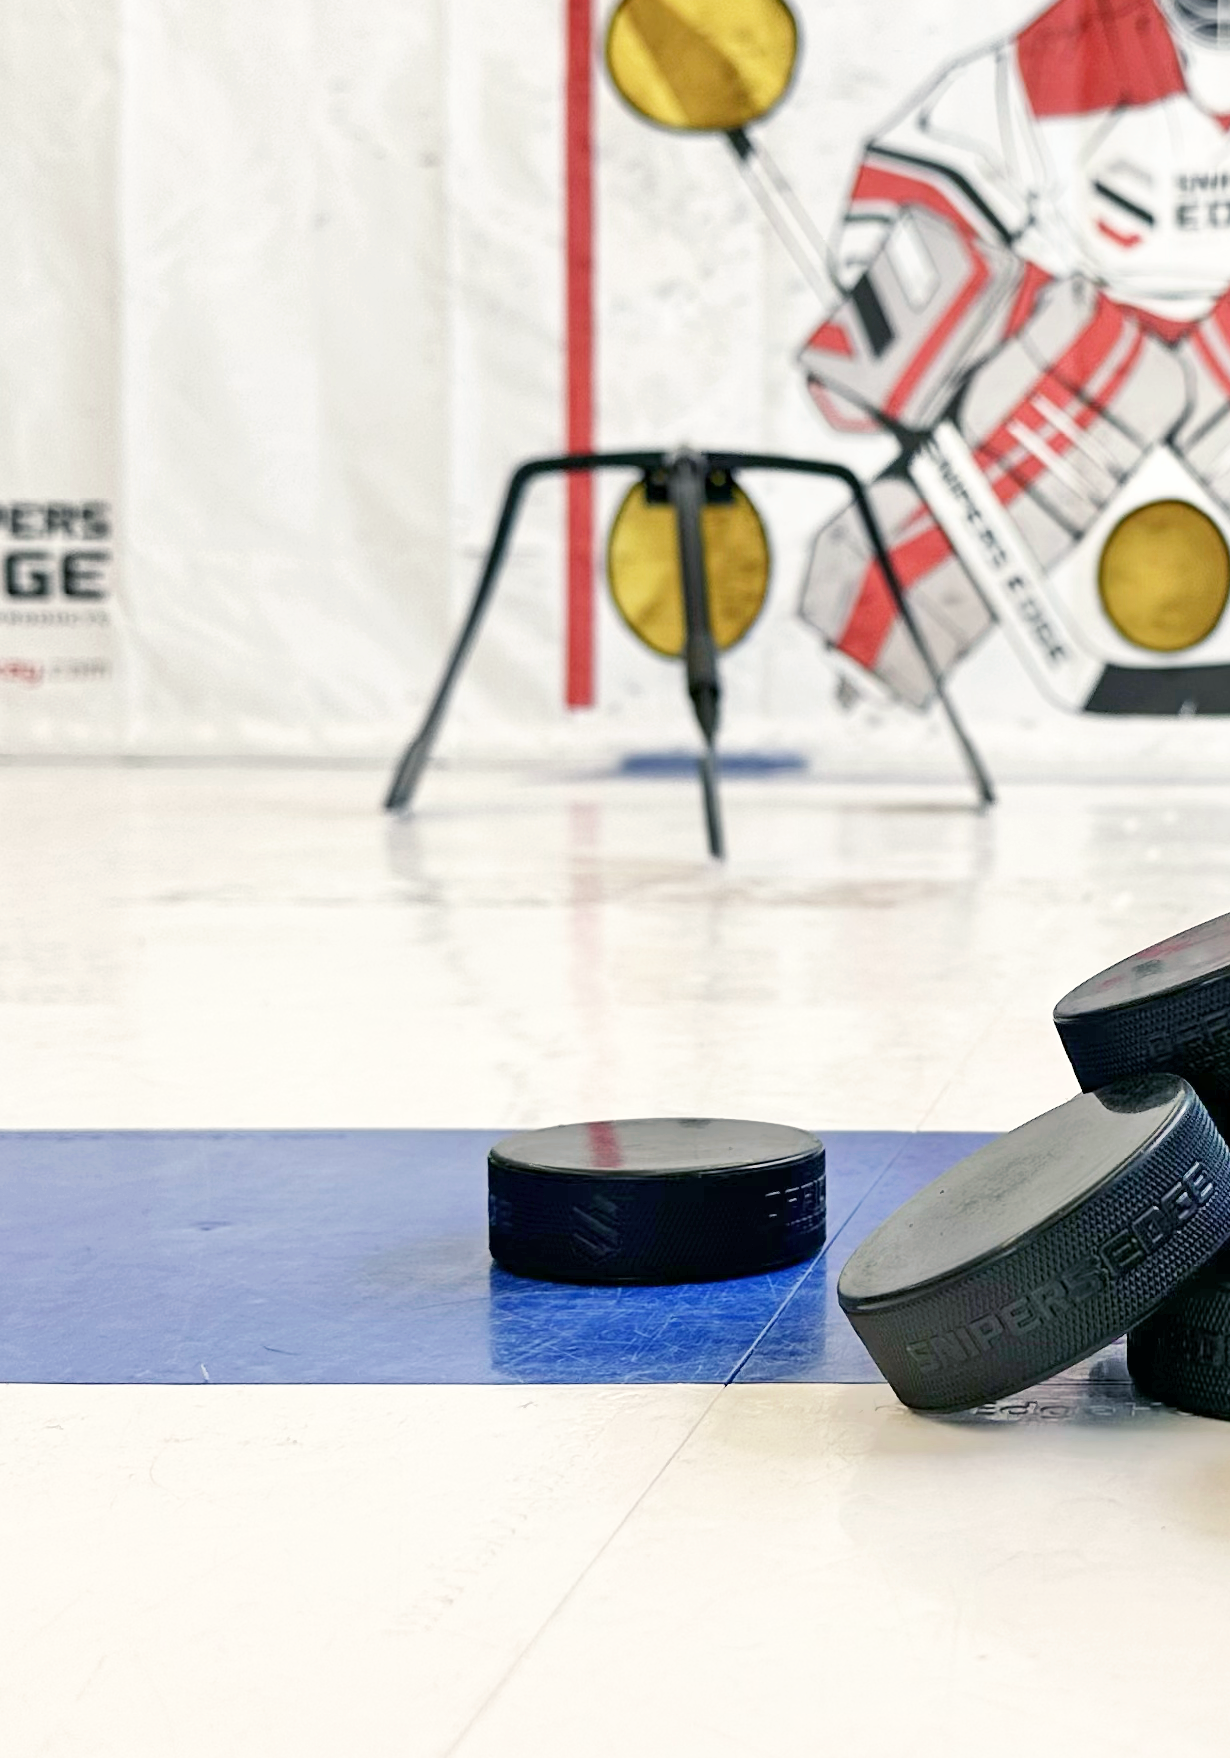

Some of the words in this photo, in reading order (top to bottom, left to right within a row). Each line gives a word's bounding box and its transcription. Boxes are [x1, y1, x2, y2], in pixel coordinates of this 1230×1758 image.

[1006, 575, 1067, 665] EDGE
[906, 1265, 1107, 1373] SNIPERS
[1100, 1161, 1214, 1273] EDGE
